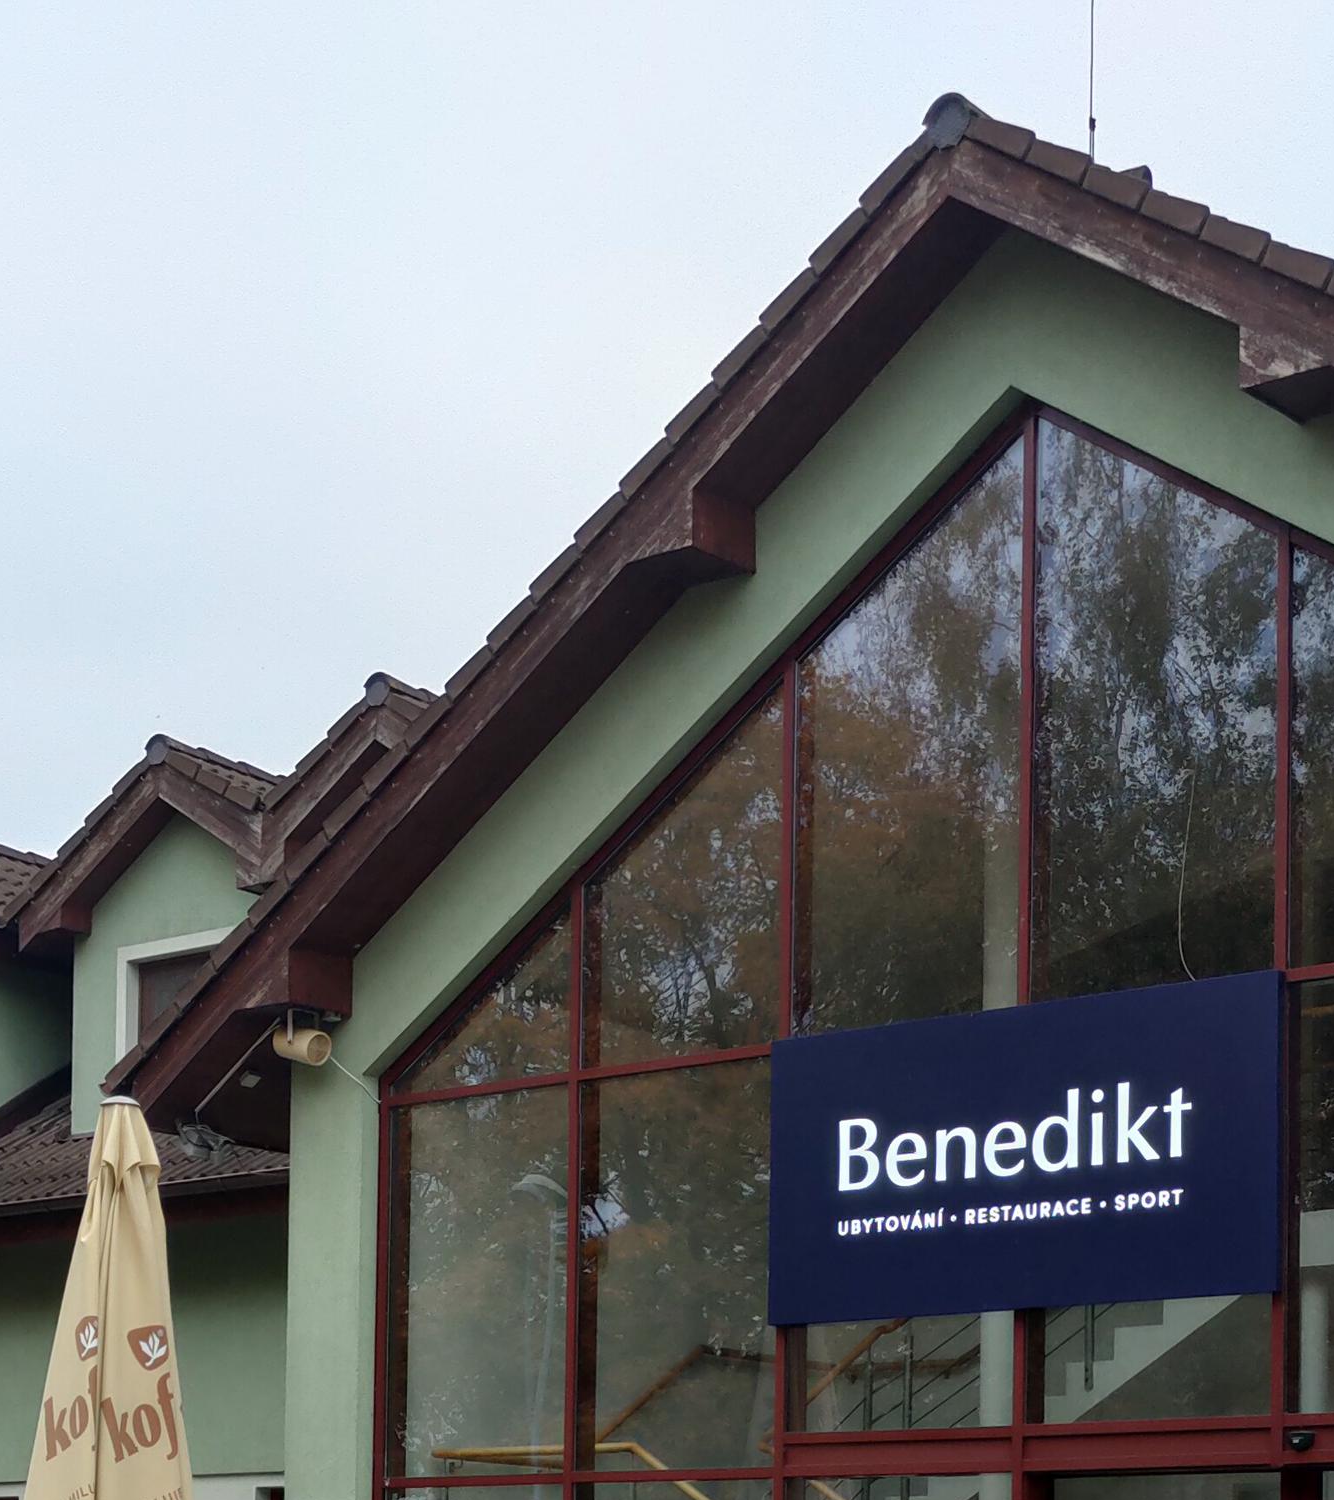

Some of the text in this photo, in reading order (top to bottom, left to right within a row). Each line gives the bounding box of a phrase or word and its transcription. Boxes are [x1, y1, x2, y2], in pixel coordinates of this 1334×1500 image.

[837, 1081, 1193, 1192] Benedikt
[836, 1188, 1185, 1237] UBYTOVÁNÍ RESTAURACE SPORT
